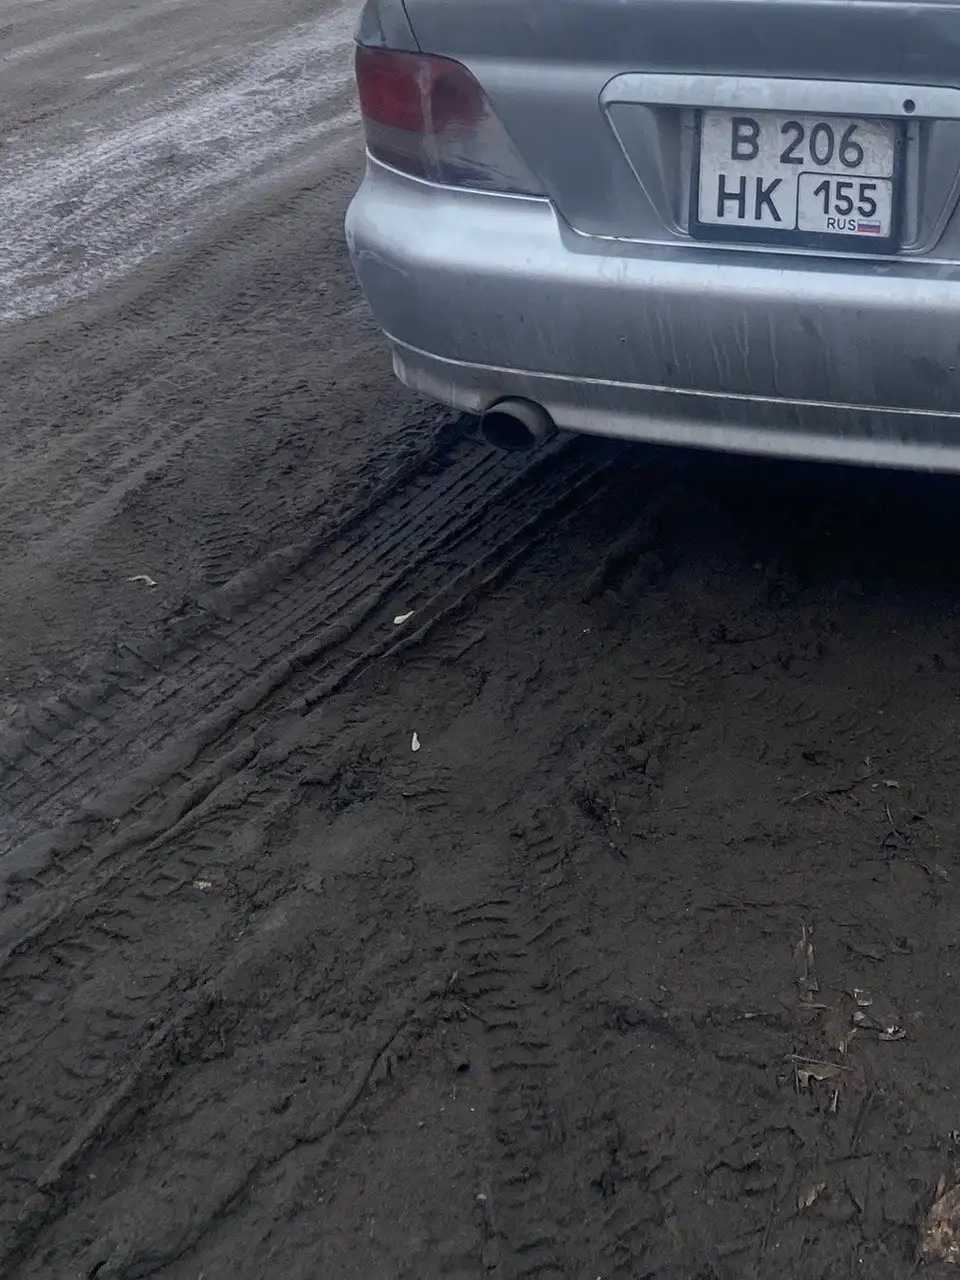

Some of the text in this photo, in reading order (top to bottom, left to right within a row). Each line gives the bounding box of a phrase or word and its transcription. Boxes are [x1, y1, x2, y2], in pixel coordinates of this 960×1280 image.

[779, 120, 864, 168] 206
[813, 180, 877, 217] 155
[826, 217, 856, 231] RUS
